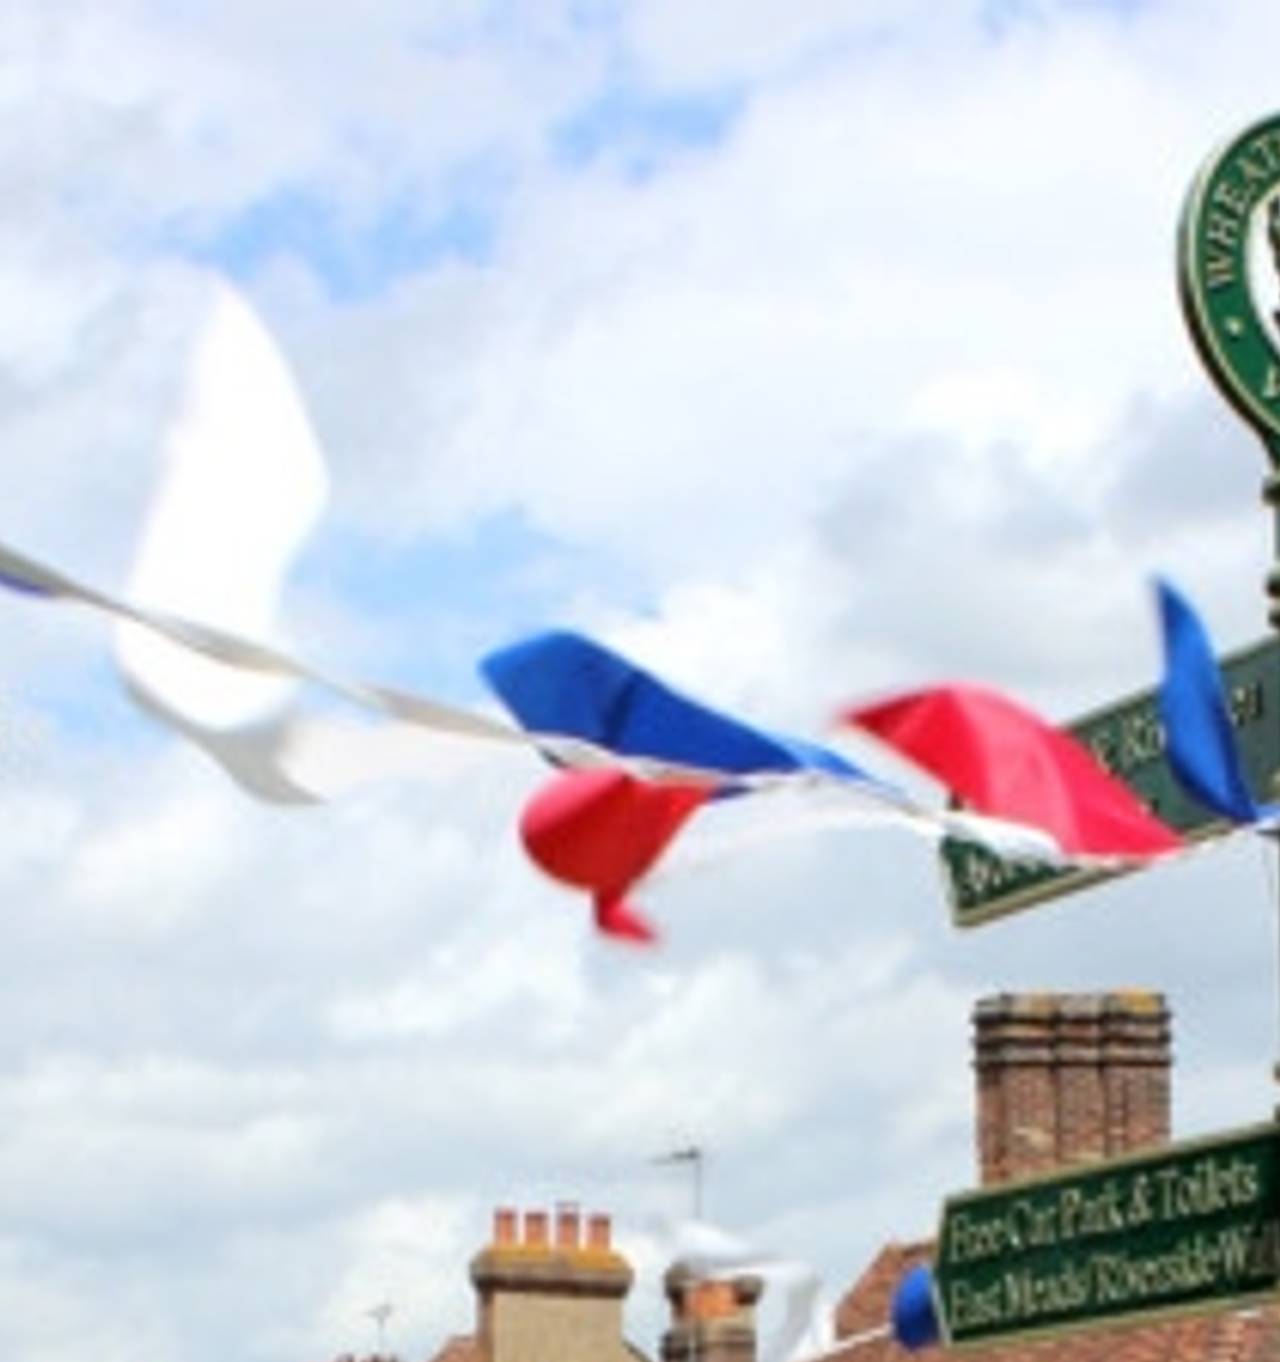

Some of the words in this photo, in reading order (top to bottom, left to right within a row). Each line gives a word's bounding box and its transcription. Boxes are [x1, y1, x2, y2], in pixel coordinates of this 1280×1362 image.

[1060, 1182, 1125, 1240] Park
[1128, 1174, 1153, 1221] &
[1158, 1157, 1259, 1219] Toilets
